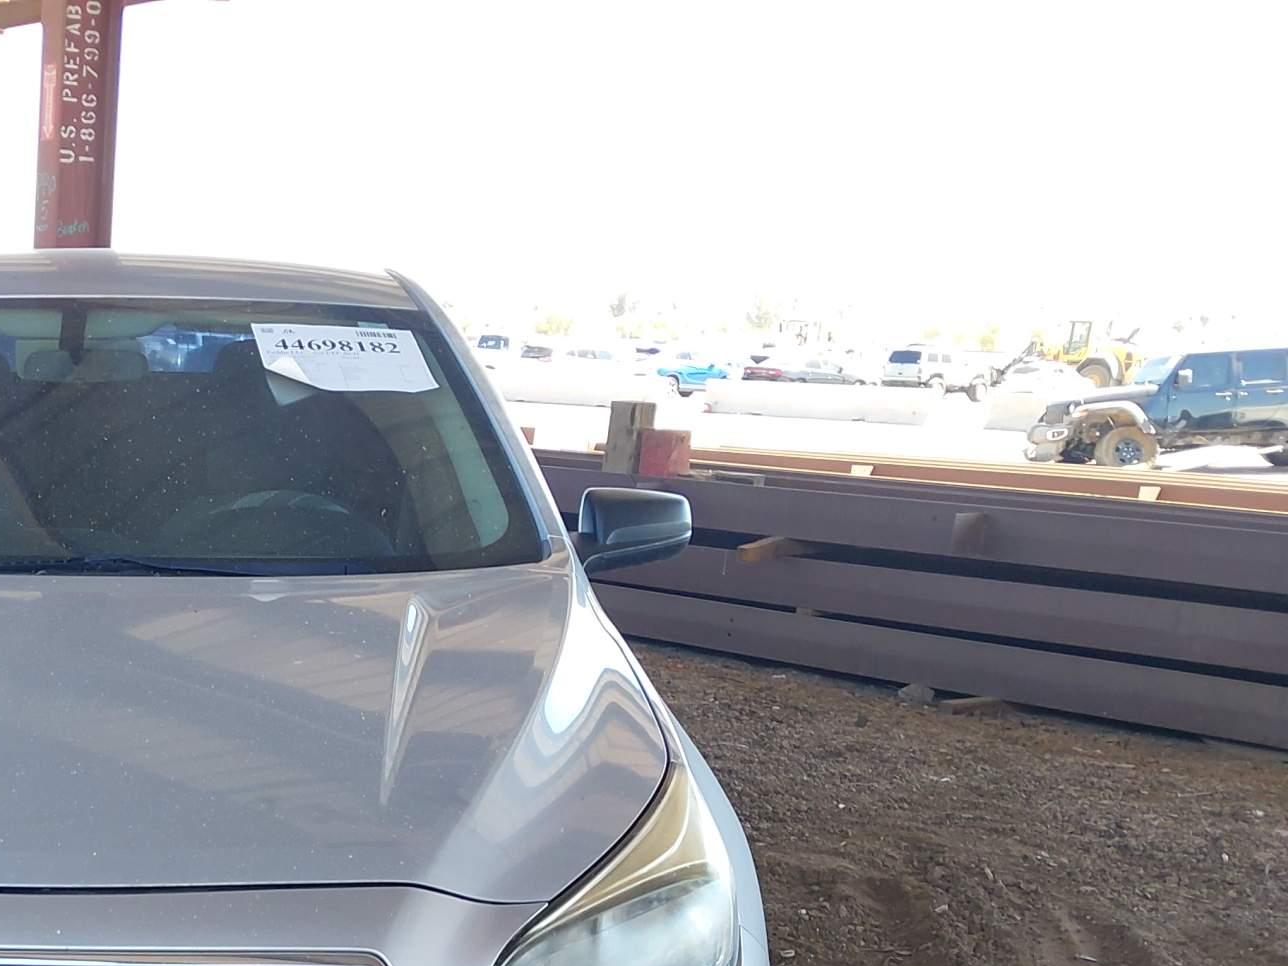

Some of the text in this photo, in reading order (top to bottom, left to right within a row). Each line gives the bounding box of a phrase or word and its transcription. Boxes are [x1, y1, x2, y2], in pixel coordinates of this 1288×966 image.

[59, 4, 82, 163] U.S. PREFAB
[79, 0, 102, 163] 1-866-799-0
[274, 337, 401, 354] 44698182
